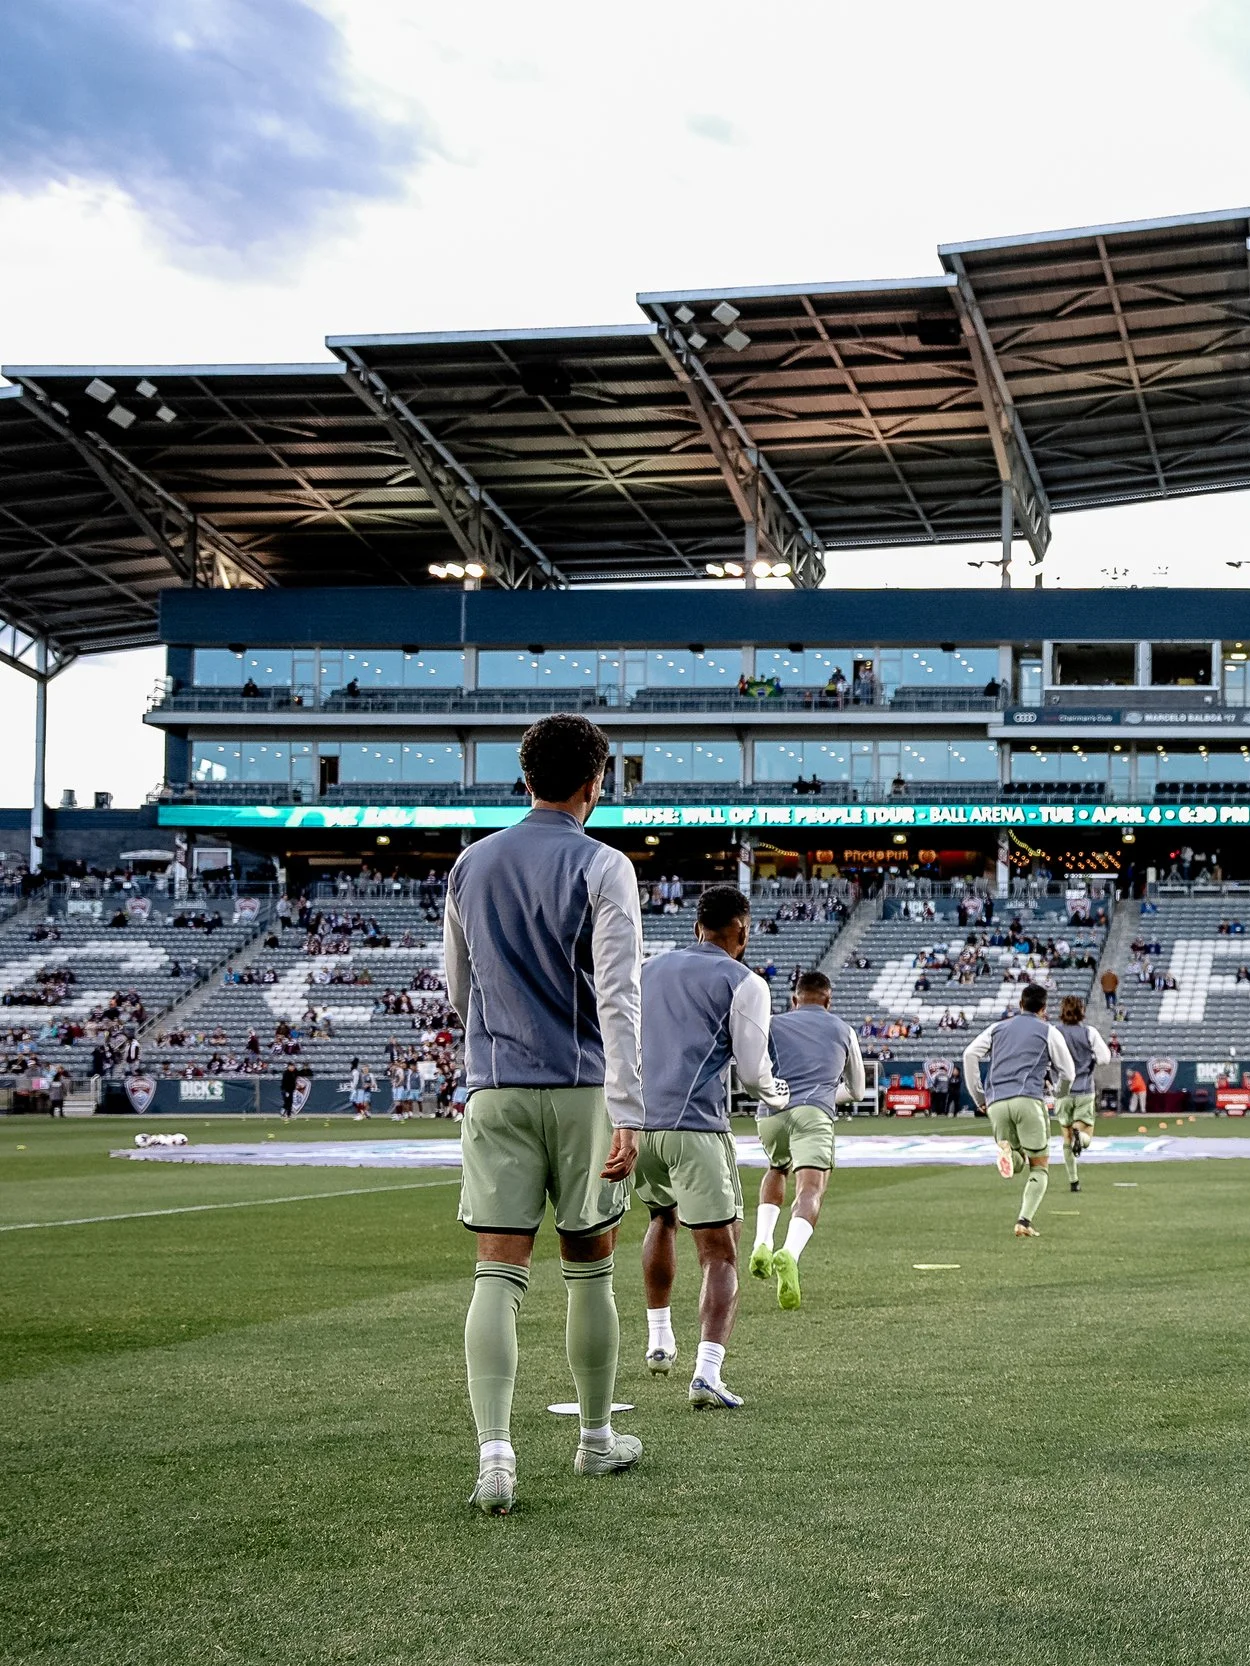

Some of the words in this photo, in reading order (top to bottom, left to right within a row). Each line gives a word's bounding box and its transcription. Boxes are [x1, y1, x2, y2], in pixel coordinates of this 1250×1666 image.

[1144, 713, 1187, 722] MARCELO
[1187, 713, 1222, 722] BALBOA
[622, 807, 680, 824] MUSE:
[682, 807, 727, 824] WILL
[728, 807, 755, 824] OF
[758, 807, 792, 824] THE
[794, 807, 863, 824] PEOPLE
[866, 807, 915, 824] TOUR
[929, 807, 967, 823] BALL
[969, 807, 1026, 823] ARENA
[1039, 807, 1074, 823] TUE
[1091, 807, 1146, 823] APRIL
[1148, 807, 1162, 823] 4
[1178, 807, 1217, 823] 6:30
[1219, 807, 1250, 823] PM
